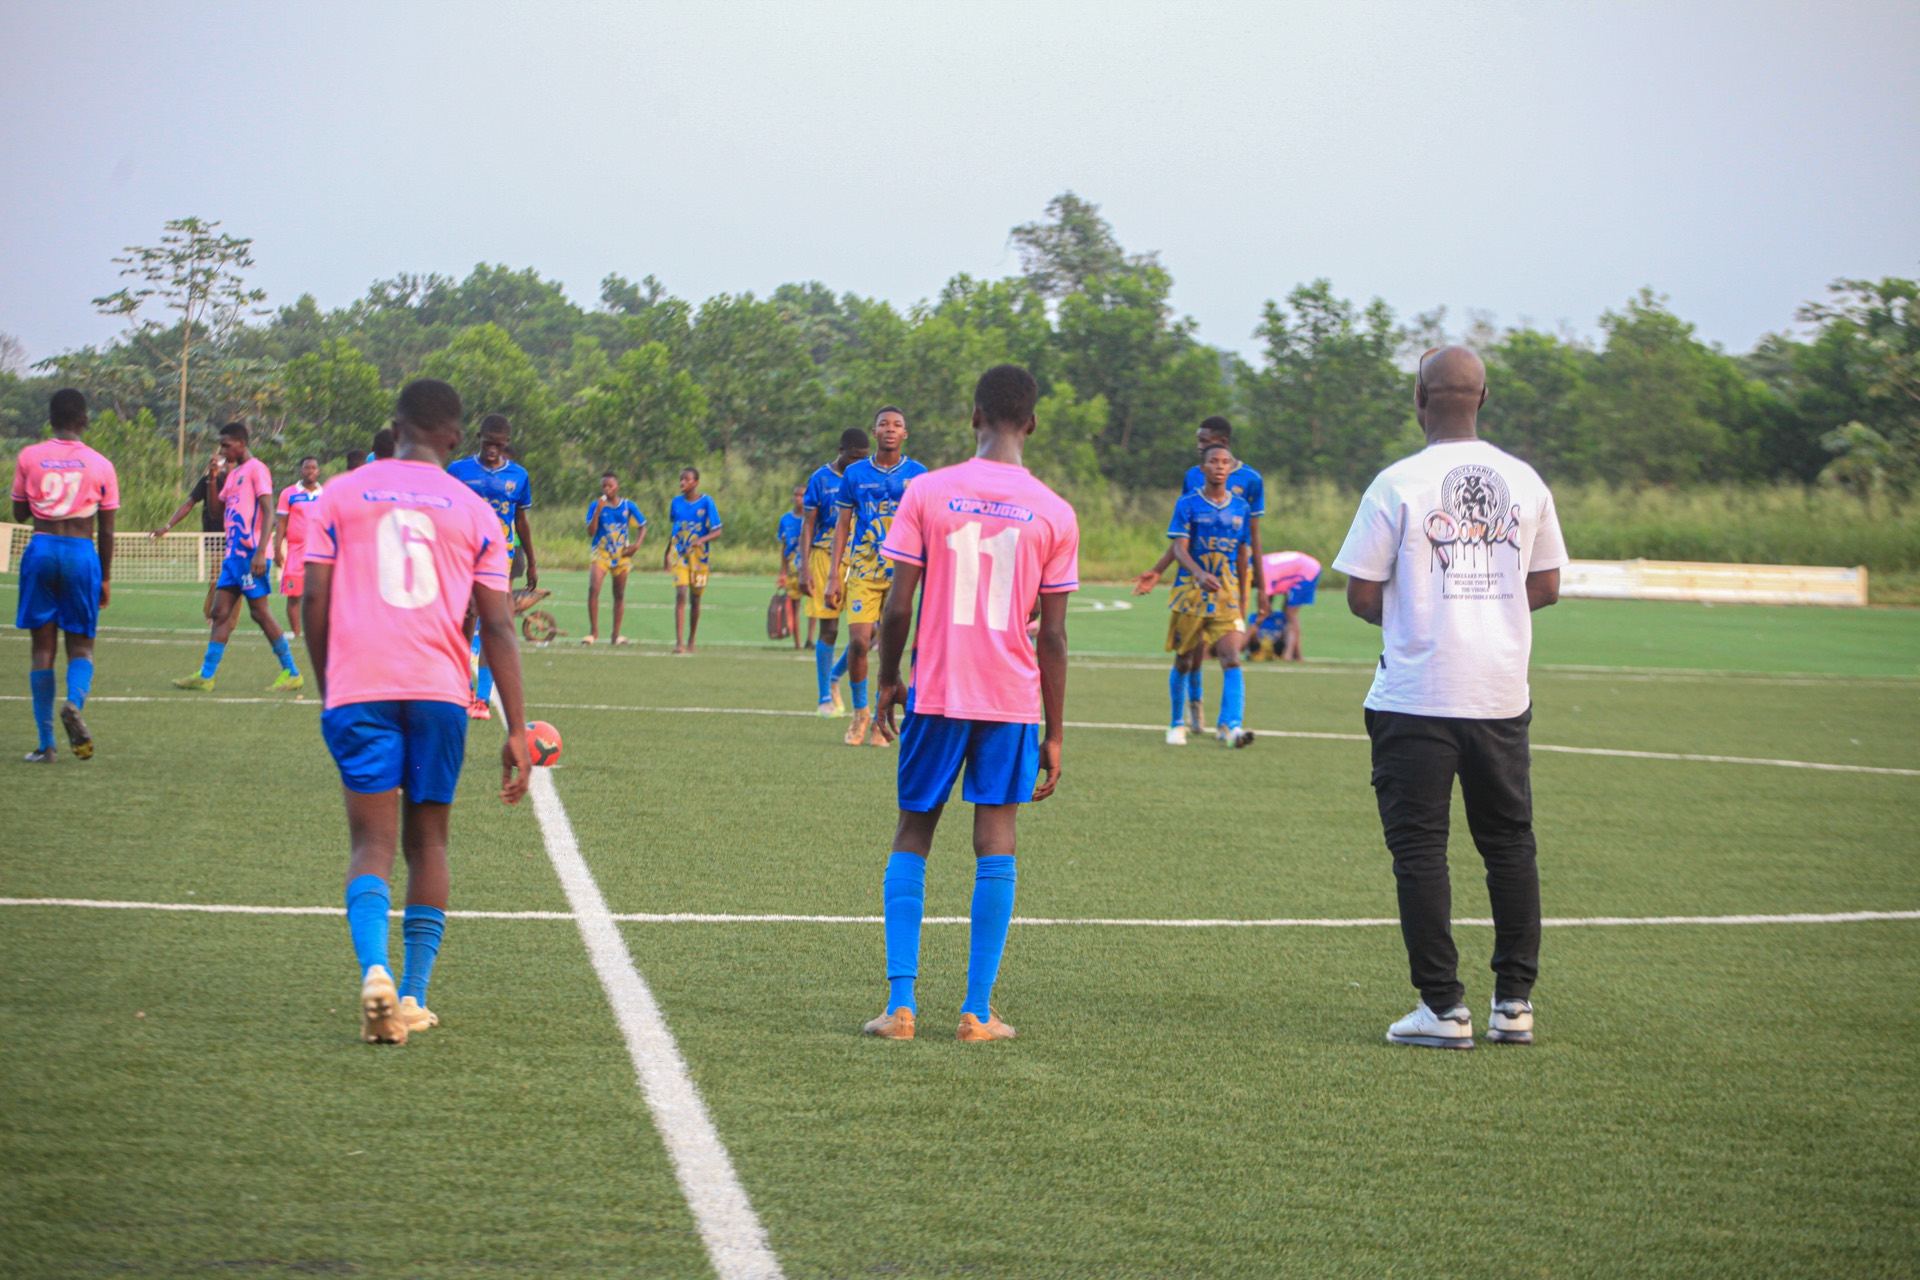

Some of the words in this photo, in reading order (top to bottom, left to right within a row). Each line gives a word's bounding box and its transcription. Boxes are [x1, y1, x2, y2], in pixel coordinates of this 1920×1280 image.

[1472, 466, 1493, 477] PARIS
[33, 472, 82, 516] 97
[951, 499, 1030, 521] YOPOUGON
[377, 508, 438, 609] 6
[695, 574, 707, 587] 21
[946, 521, 1020, 631] 11
